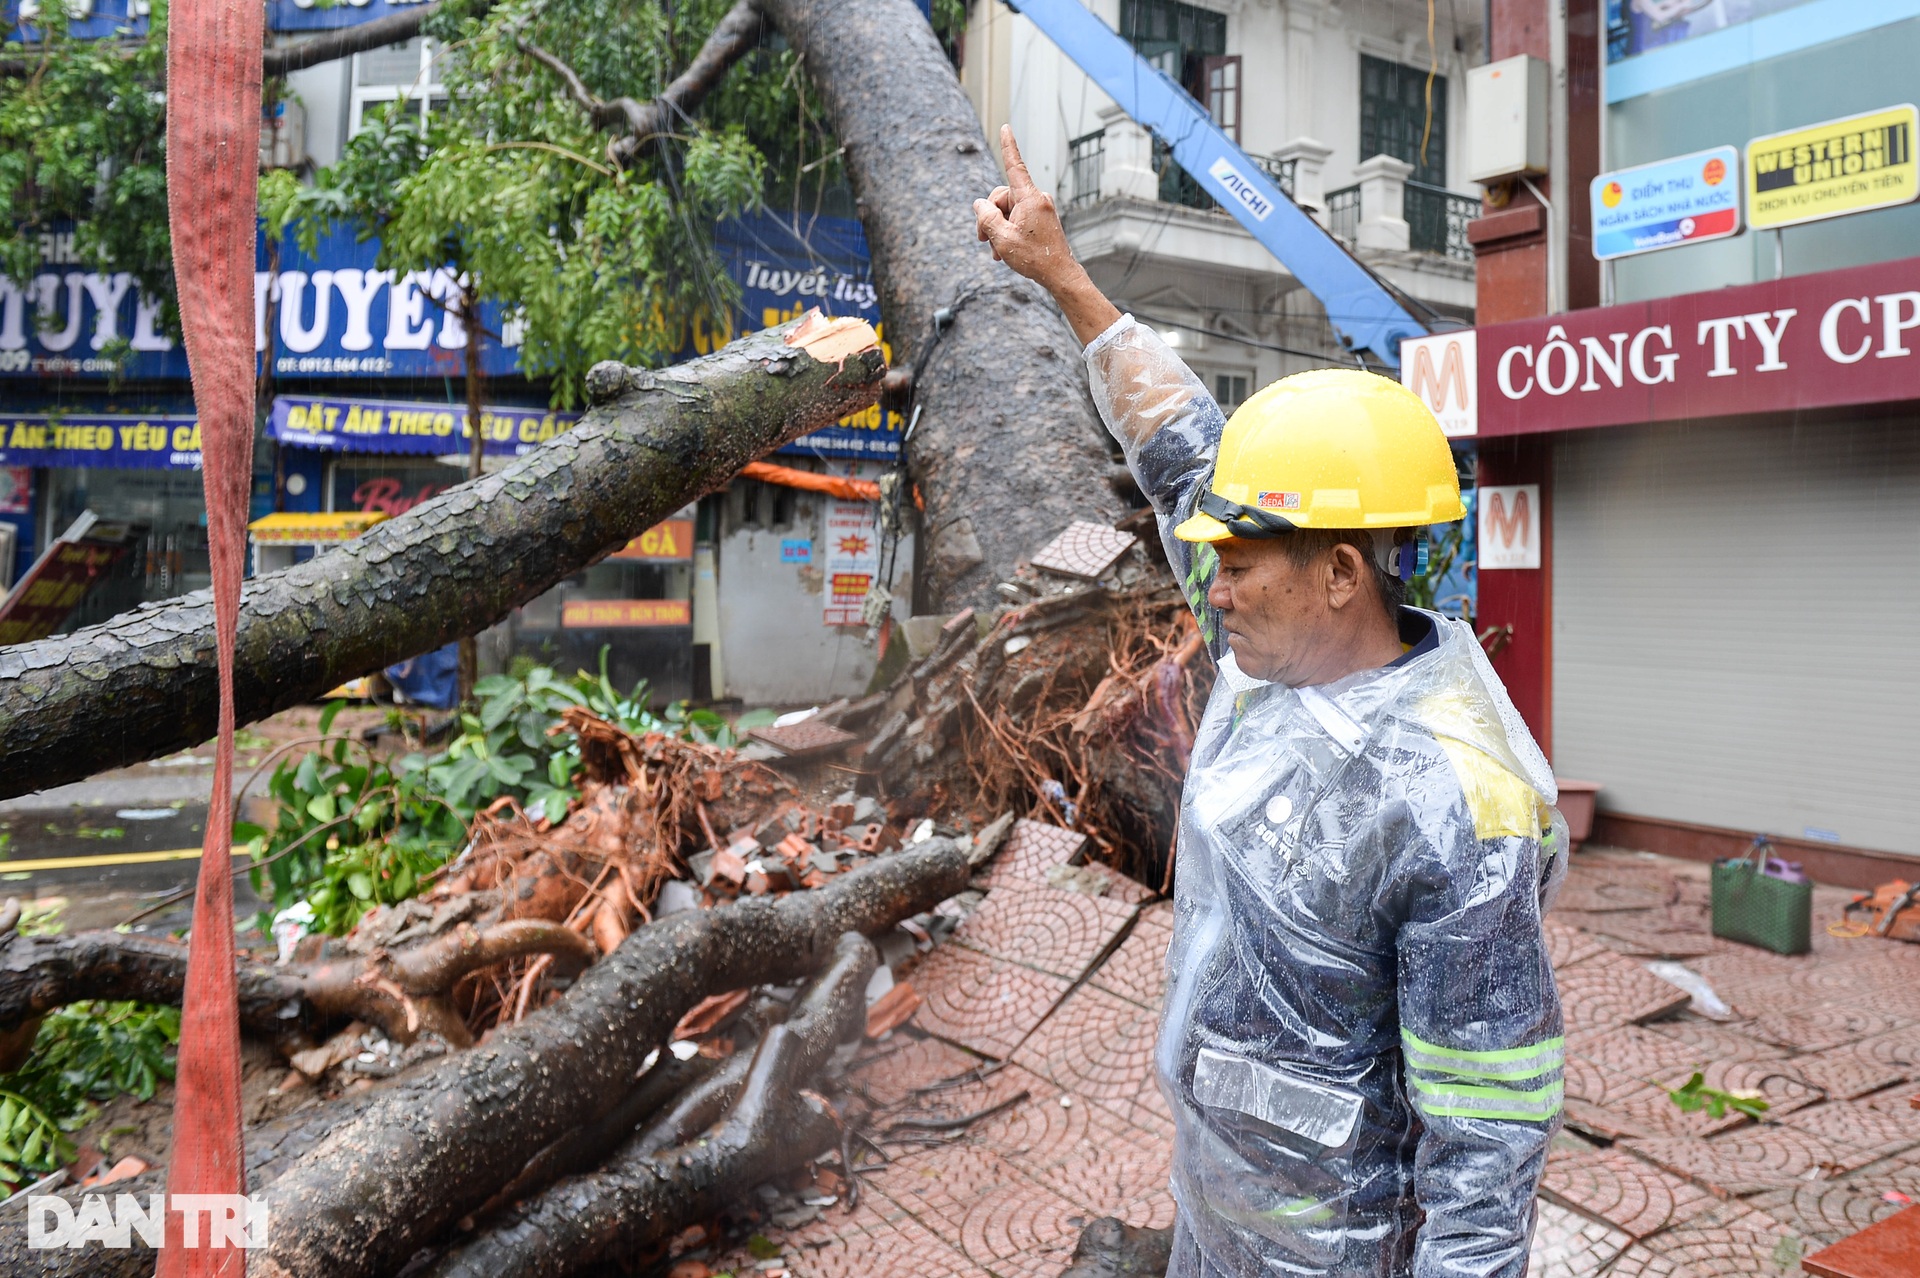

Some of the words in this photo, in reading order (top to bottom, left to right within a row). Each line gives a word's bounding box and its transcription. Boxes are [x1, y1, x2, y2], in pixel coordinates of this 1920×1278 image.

[1756, 129, 1882, 174] WESTERN
[1793, 149, 1883, 185] UNION
[1223, 175, 1268, 214] AICHI
[1497, 325, 1680, 400] CÔNG
[1697, 308, 1798, 378] TY
[1819, 291, 1920, 364] CP
[54, 425, 114, 450] THEO
[119, 422, 168, 451] YÊU
[287, 403, 340, 434] ĐẶT
[343, 404, 384, 434] ĂN
[388, 410, 455, 437] THEO
